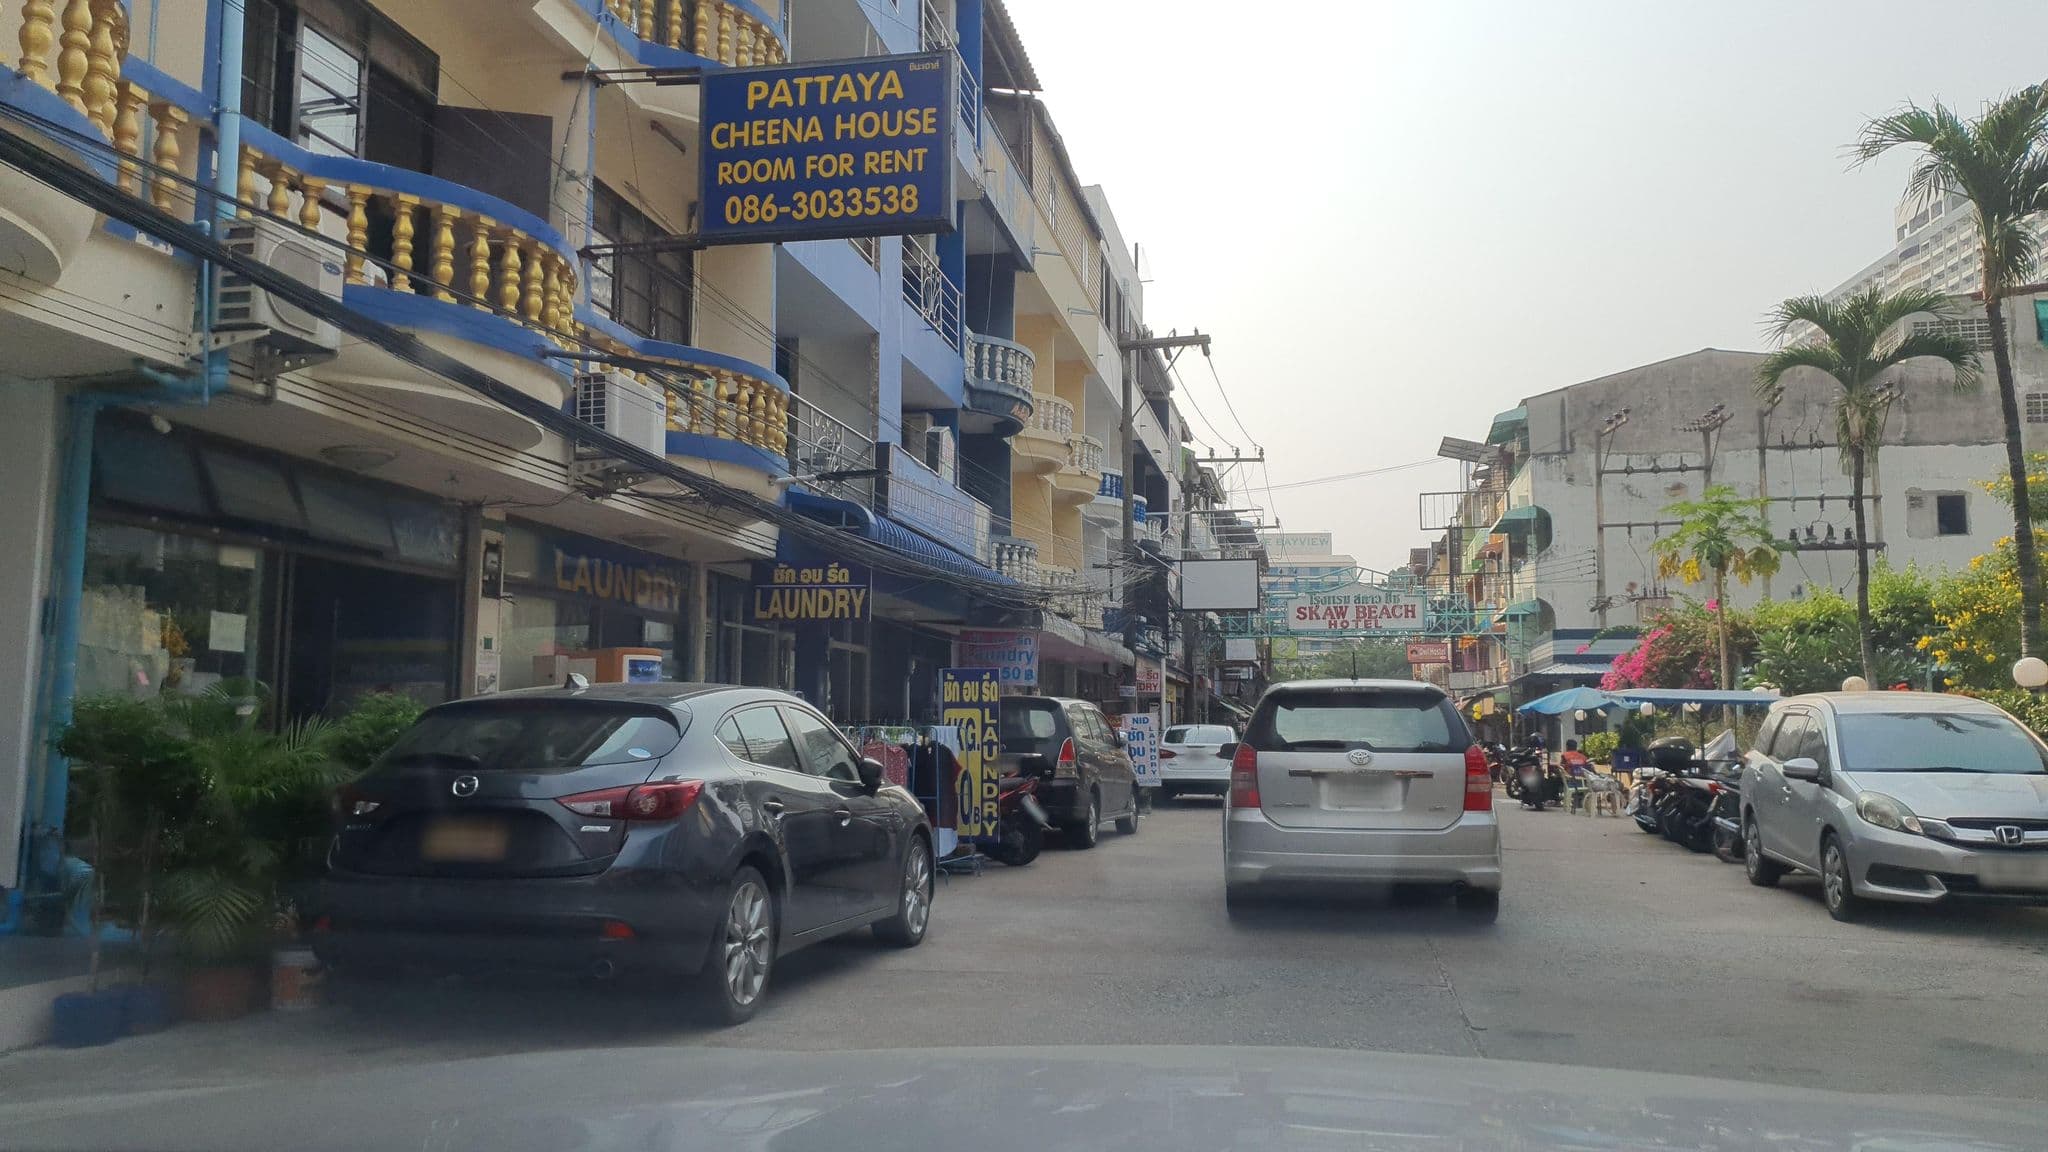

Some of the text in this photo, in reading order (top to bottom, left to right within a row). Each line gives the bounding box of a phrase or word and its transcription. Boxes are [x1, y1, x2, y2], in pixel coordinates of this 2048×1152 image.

[747, 70, 904, 110] PATTAYA
[711, 108, 937, 149] CHEENA HOUSE
[718, 148, 928, 185] ROOM FOR RENT
[725, 184, 919, 224] 086-3033538
[1276, 535, 1329, 546] BAYVIEW
[554, 546, 680, 613] LAUNDRY
[755, 588, 866, 619] LAUNDRY
[1296, 604, 1416, 620] SKAW BEACH
[1328, 619, 1382, 629] HOTEL
[1132, 716, 1149, 725] NID
[1149, 726, 1157, 775] LAUNDRY
[983, 708, 998, 836] LAUNDRY
